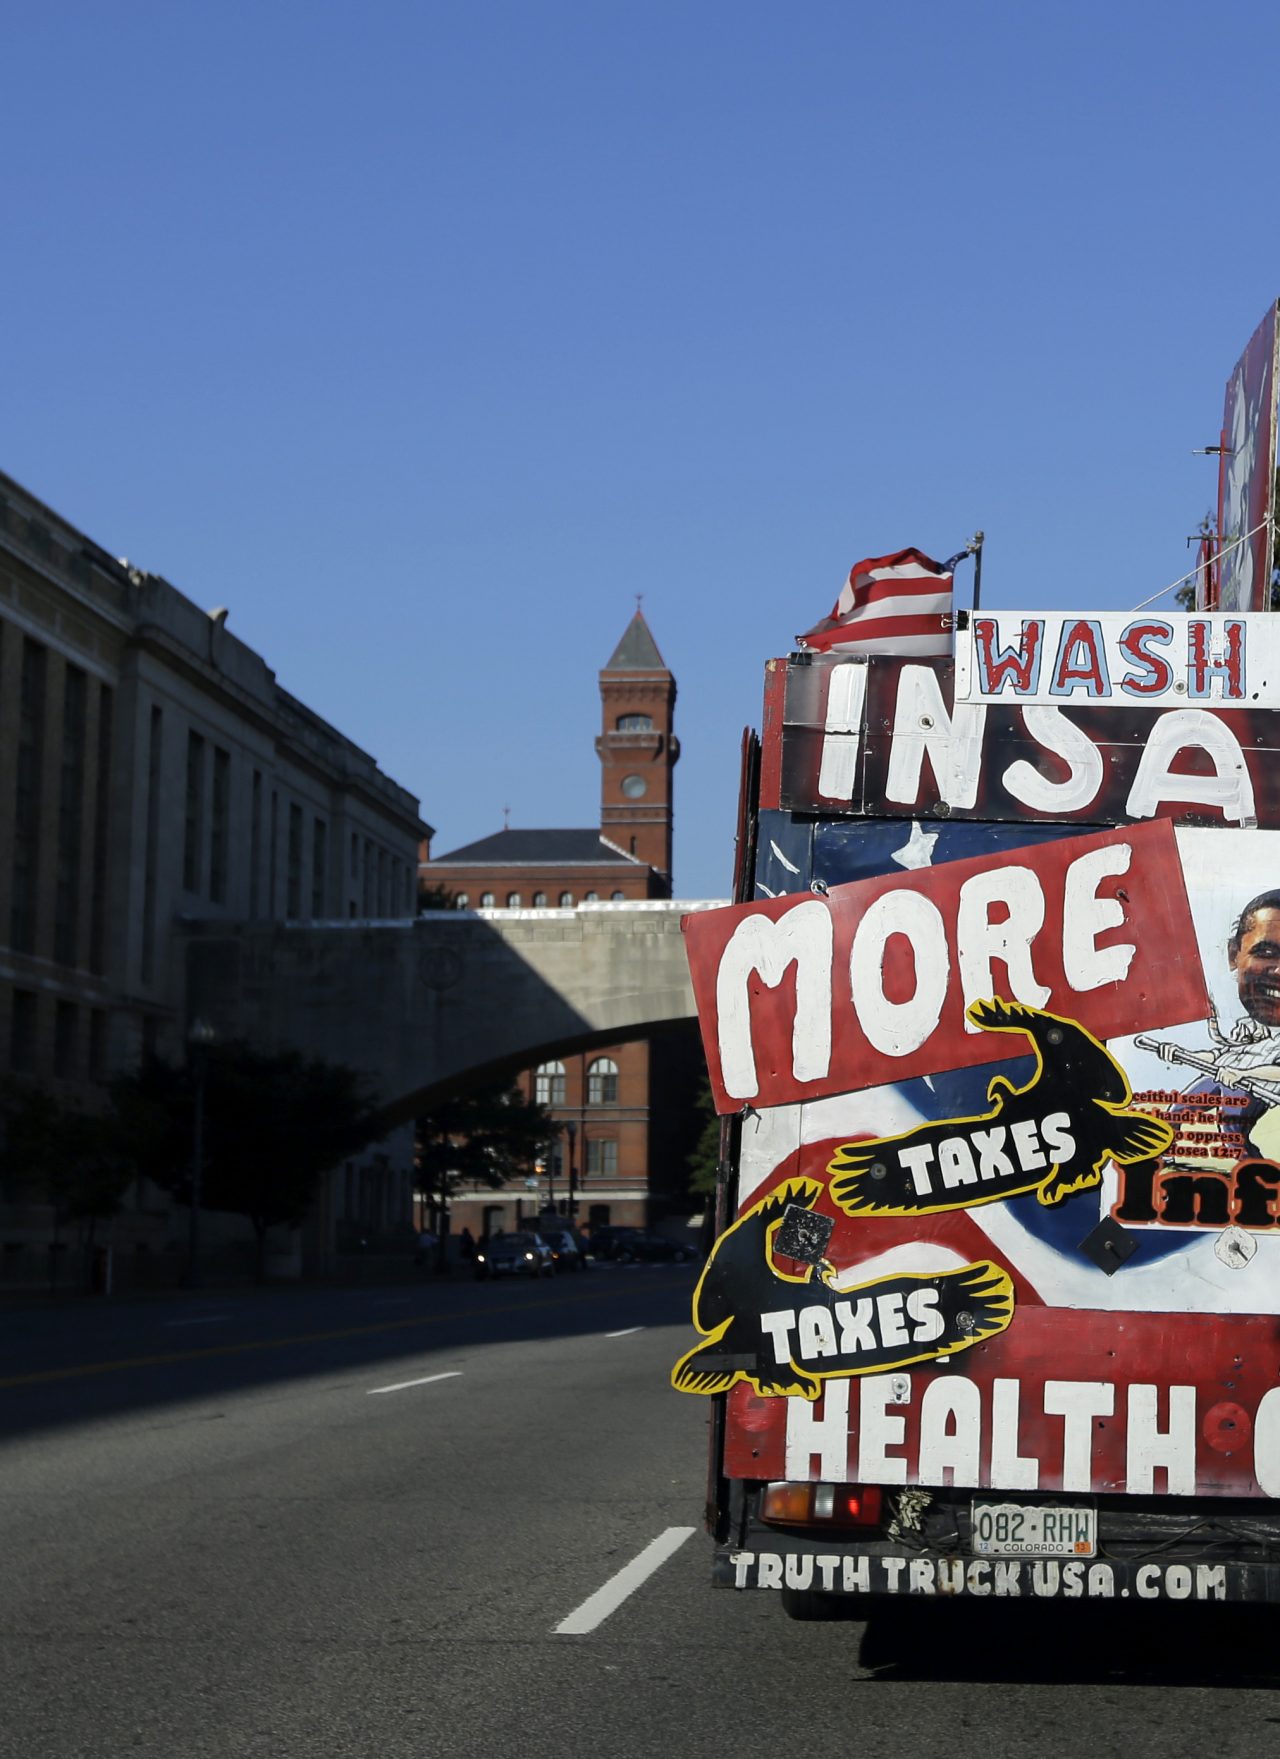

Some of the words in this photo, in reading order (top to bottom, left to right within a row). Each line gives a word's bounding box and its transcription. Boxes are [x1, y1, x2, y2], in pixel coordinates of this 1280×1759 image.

[974, 618, 1247, 699] WASH
[716, 843, 1136, 1099] MORE
[1133, 1089, 1178, 1103] ceitful
[1181, 1091, 1222, 1105] scales
[1225, 1096, 1248, 1106] are
[1197, 1110, 1216, 1124] he
[899, 1112, 1076, 1196] TAXES
[1187, 1132, 1241, 1146] oppress
[1211, 1148, 1243, 1159] 12:7
[761, 1288, 945, 1364] TAXES
[785, 1373, 1197, 1496] HEALTH
[1004, 1543, 1064, 1552] COLORADO
[730, 1553, 870, 1591] TRUTH
[881, 1557, 1021, 1597] TRUCK
